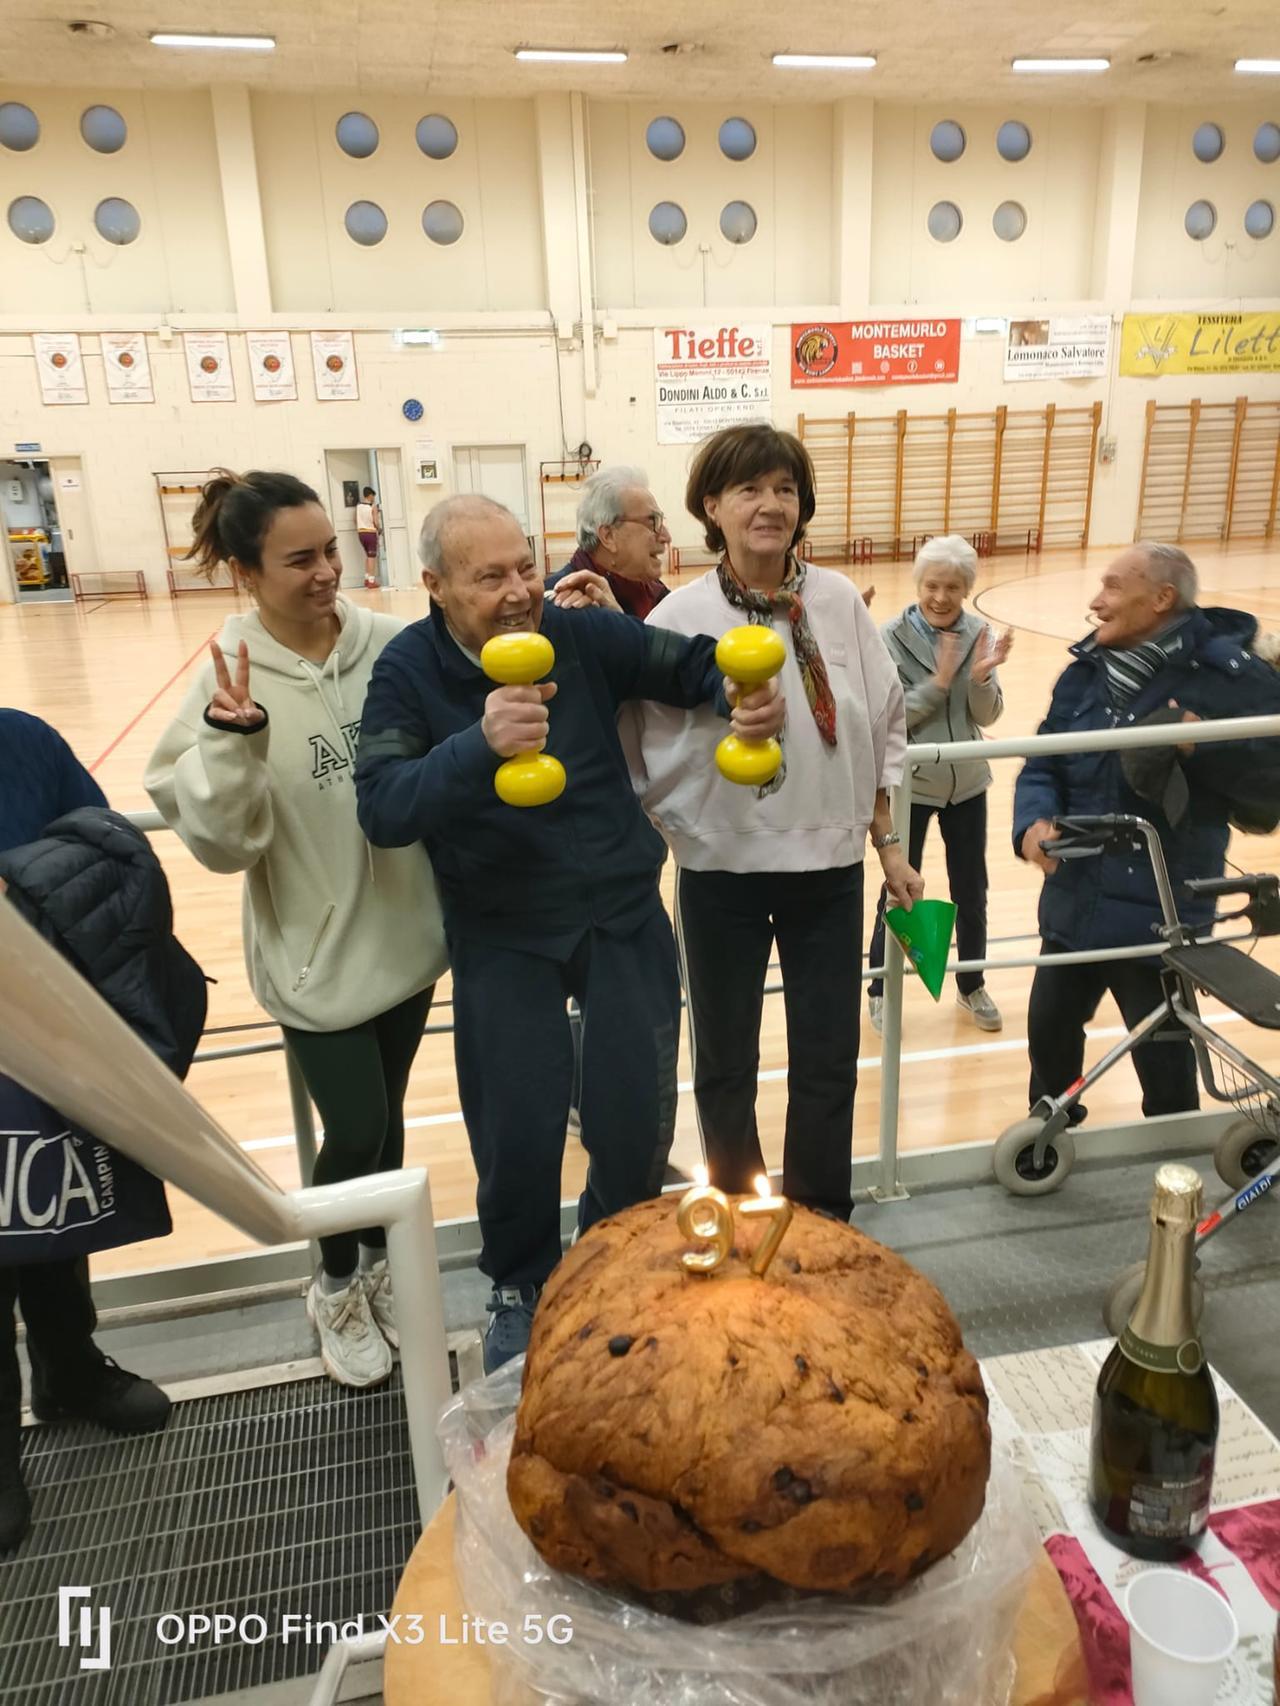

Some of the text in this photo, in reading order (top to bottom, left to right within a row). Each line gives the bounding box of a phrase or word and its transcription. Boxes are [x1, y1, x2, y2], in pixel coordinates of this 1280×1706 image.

[851, 322, 947, 339] MONTEMURLO
[664, 327, 755, 360] Tieffe
[873, 343, 925, 359] BASKET
[1007, 346, 1105, 361] Lomonaco Salvatore
[730, 388, 738, 399] &
[741, 383, 752, 398] C.
[677, 1186, 793, 1280] 97
